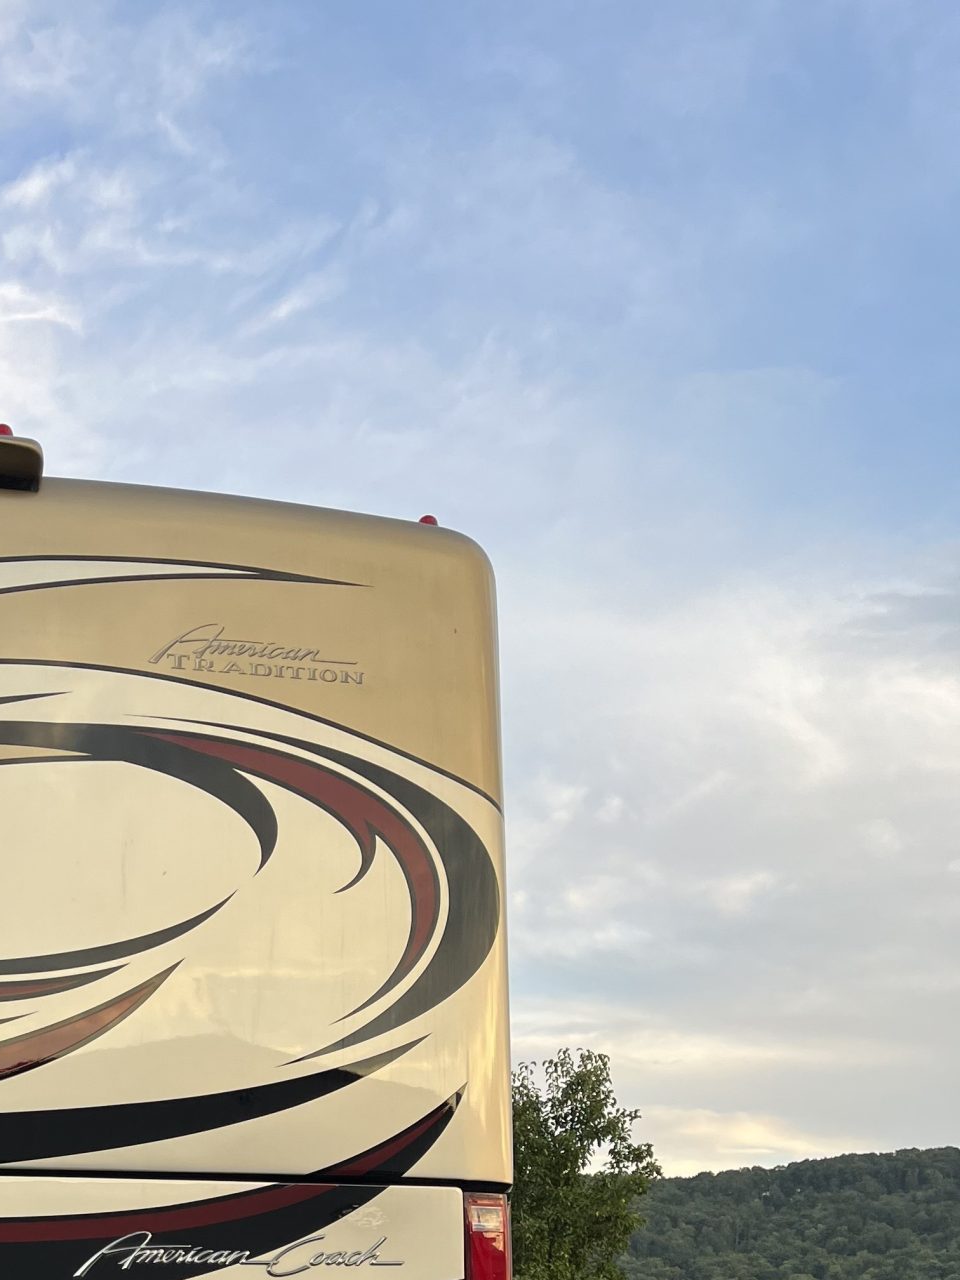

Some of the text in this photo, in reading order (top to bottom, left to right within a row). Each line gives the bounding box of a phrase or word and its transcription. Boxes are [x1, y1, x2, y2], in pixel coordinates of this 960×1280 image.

[148, 623, 358, 664] American
[166, 653, 365, 685] TRADITION
[73, 1230, 404, 1278] American Coach
